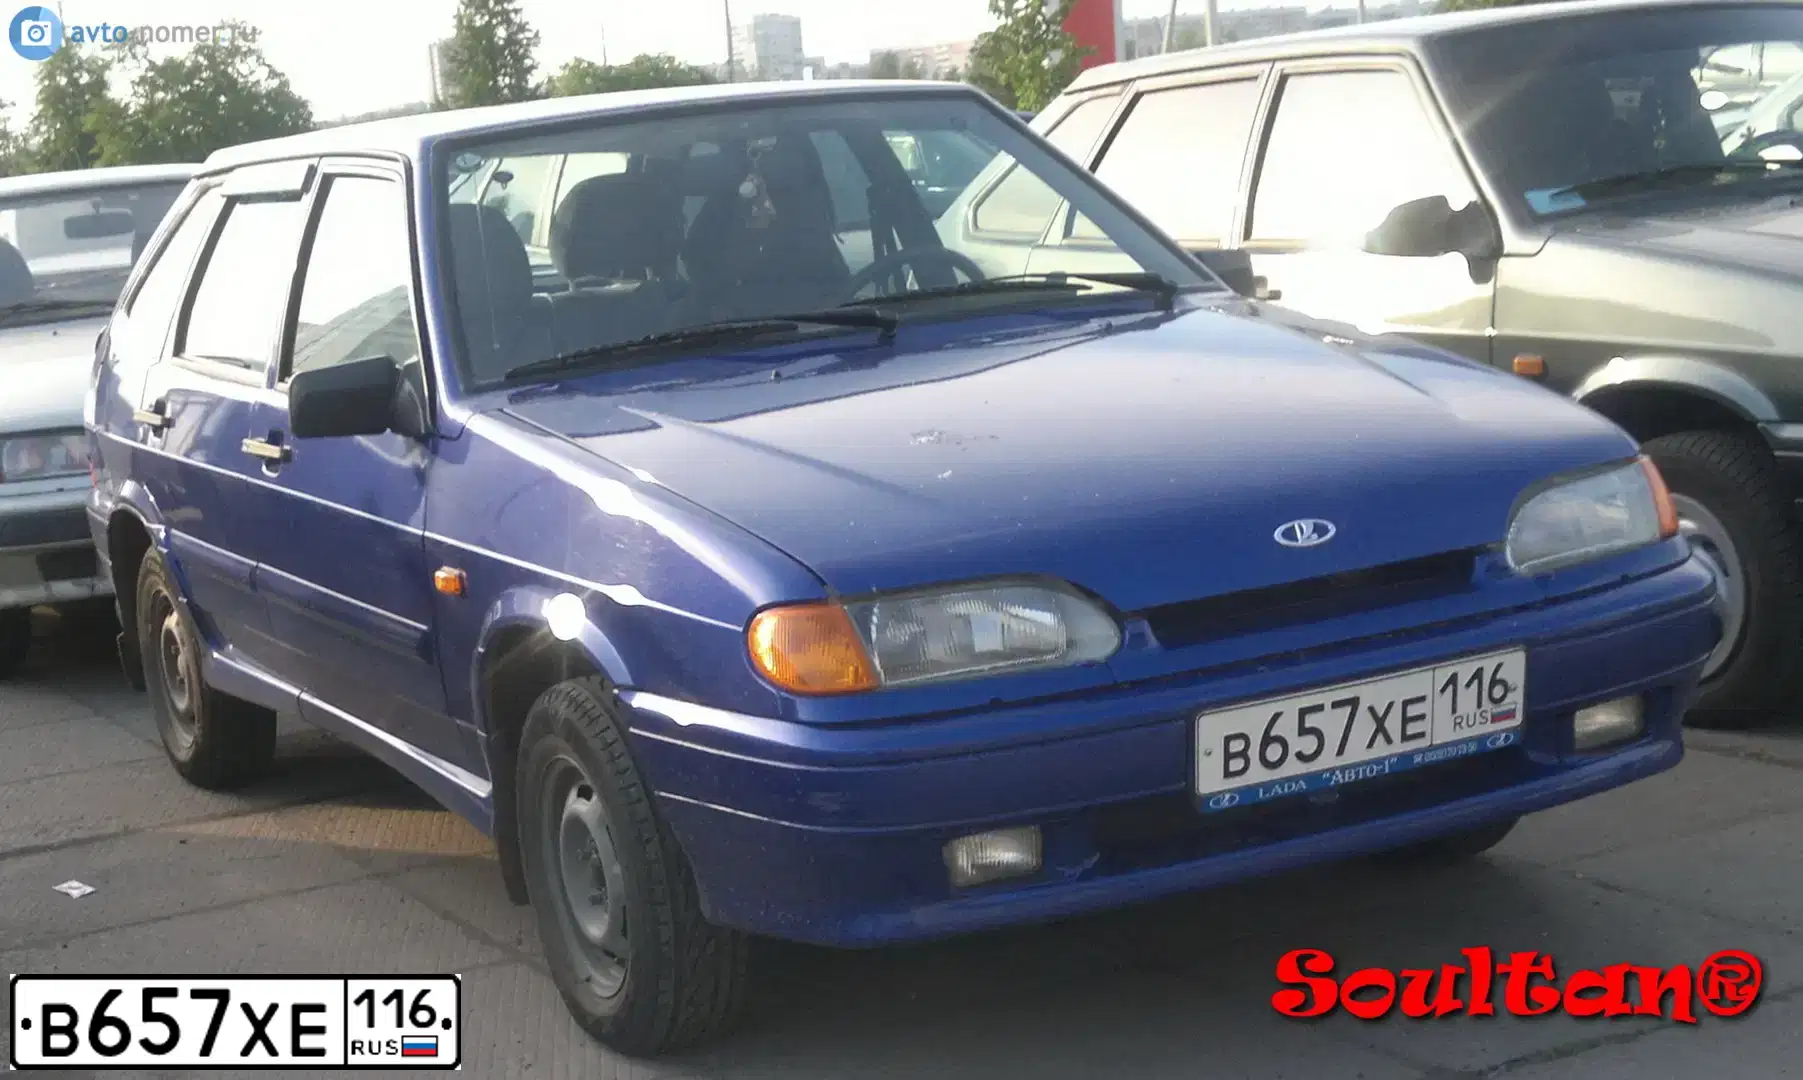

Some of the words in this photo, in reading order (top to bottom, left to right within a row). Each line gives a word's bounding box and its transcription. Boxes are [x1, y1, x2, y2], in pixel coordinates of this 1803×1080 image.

[1222, 696, 1428, 780] В657ХЕ
[1438, 661, 1510, 716] 116
[1452, 709, 1490, 733] RUS
[1258, 779, 1308, 799] LADA
